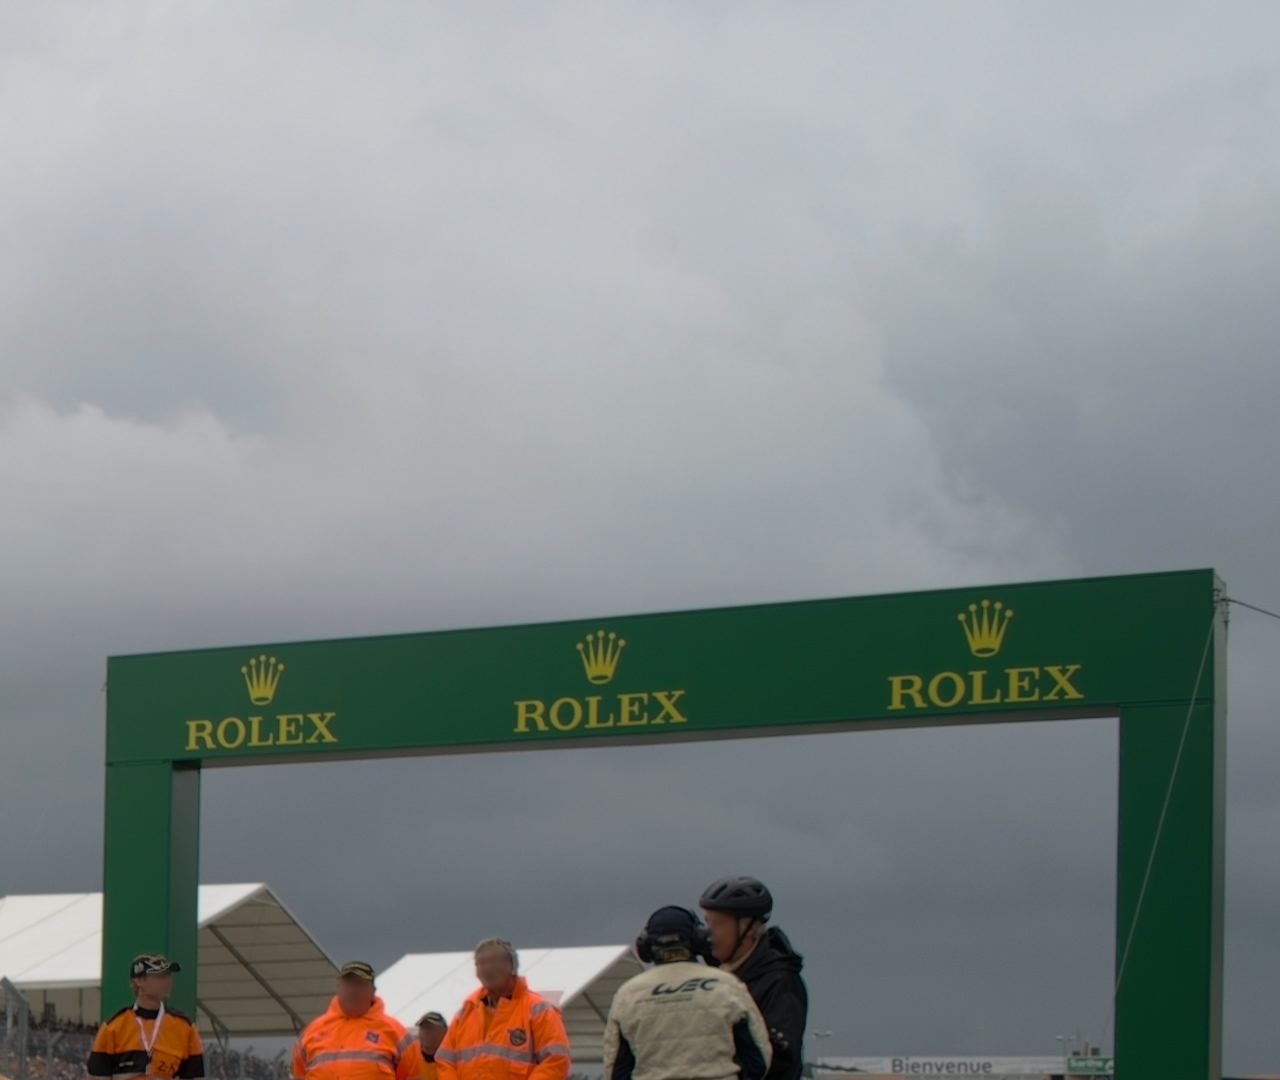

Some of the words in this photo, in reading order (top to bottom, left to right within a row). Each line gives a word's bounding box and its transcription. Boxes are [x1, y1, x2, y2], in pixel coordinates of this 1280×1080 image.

[886, 664, 1085, 711] ROLEX
[512, 690, 688, 733] ROLEX
[184, 712, 338, 751] ROLEX
[651, 978, 718, 996] WEC
[891, 1057, 993, 1074] Bienvenue
